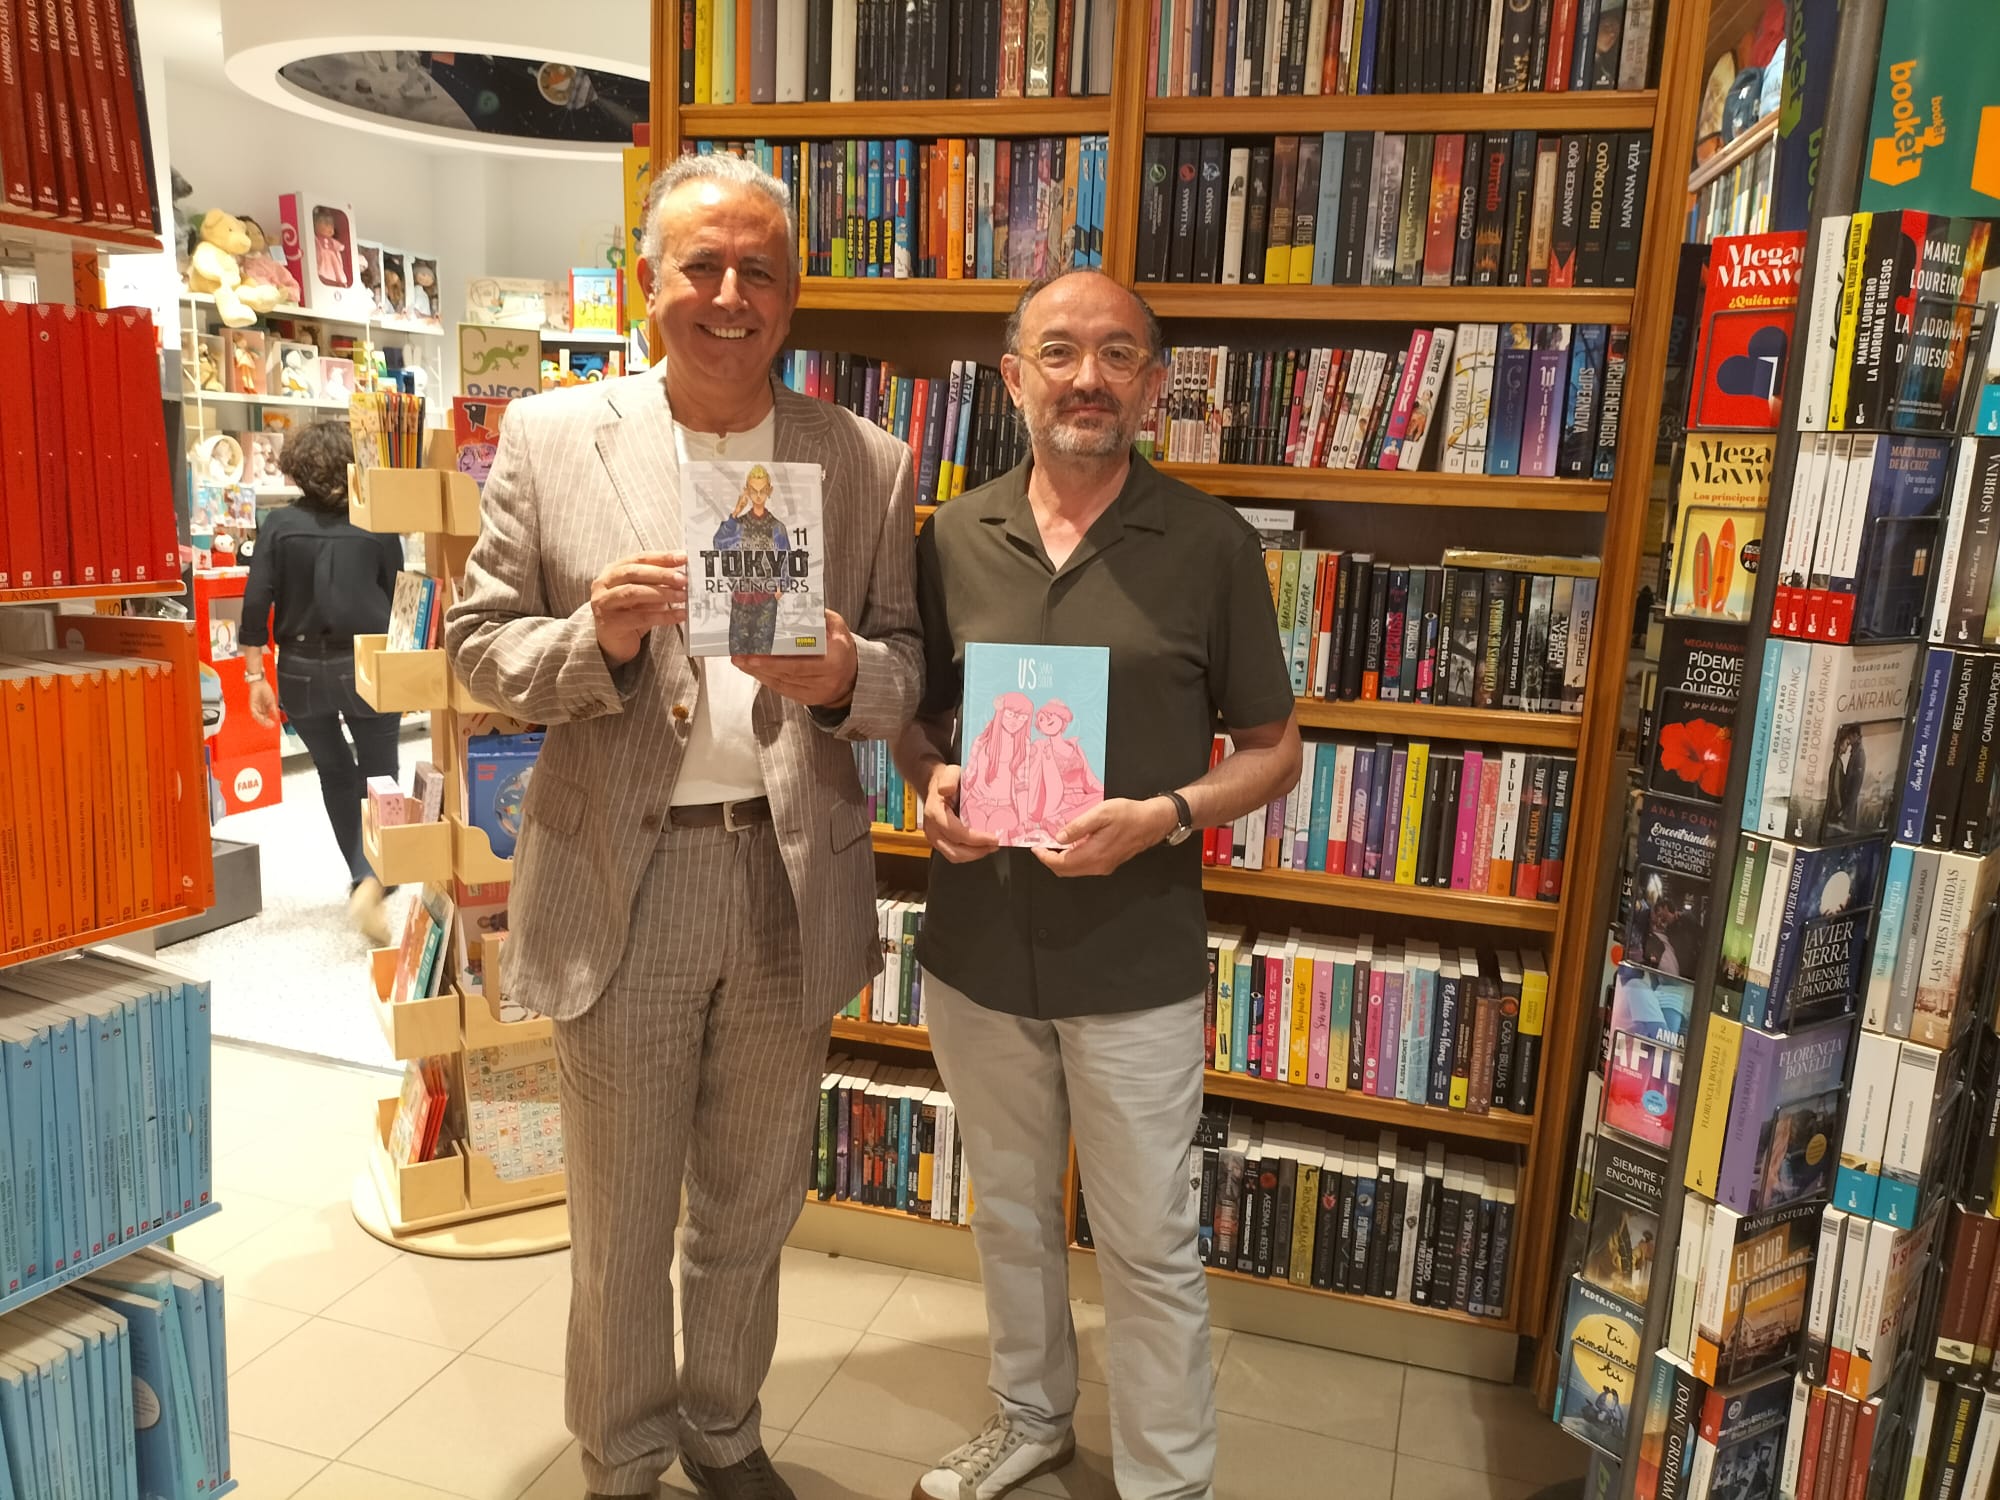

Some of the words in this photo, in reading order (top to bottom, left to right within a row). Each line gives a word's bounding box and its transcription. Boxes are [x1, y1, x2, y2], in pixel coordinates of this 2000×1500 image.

[89, 17, 102, 56] TEMPLO
[94, 58, 104, 70] EL
[1889, 59, 1923, 168] booket
[1930, 95, 1947, 143] booket
[1567, 140, 1579, 165] ROJO
[1628, 139, 1641, 172] AZUL
[1592, 141, 1609, 199] DORADO
[1181, 187, 1191, 223] LLAMAS
[1204, 187, 1214, 224] SINSAJO
[1562, 166, 1577, 228] AMANECER
[1620, 173, 1637, 228] MAÑANA
[1589, 200, 1602, 230] HIJO
[1179, 223, 1187, 237] EN
[1728, 243, 1806, 268] Mega
[1923, 239, 1961, 265] MANEL
[1878, 258, 1894, 300] HUESOS
[1909, 268, 1965, 297] LOUREIRO
[1728, 294, 1771, 309] ¿Quién
[1875, 301, 1886, 316] DE
[1856, 337, 1870, 365] MANEL
[1863, 276, 1878, 335] LOUREIRO
[1894, 313, 1910, 334] LA
[1915, 318, 1963, 341] ADRONA
[1868, 317, 1885, 365] LADRONA
[1912, 350, 1954, 370] HUESOS
[1316, 360, 1328, 392] TAKOPI
[1425, 375, 1436, 386] 10
[1866, 366, 1878, 382] LA
[1452, 382, 1469, 435] TRIBUTO
[1475, 388, 1488, 430] VALOR
[1535, 366, 1556, 457] Winter
[1573, 366, 1595, 435] SUPERNOVA
[1599, 356, 1625, 448] ARCHIENEMIGOS
[1690, 461, 1772, 486] Maxw
[793, 527, 808, 546] 11
[1975, 516, 1990, 535] LA
[700, 549, 810, 578] TOKYO
[705, 579, 809, 593] REVENGERS
[1489, 599, 1505, 636] SOMBRAS
[1367, 618, 1380, 669] EVERLESS
[1489, 635, 1501, 647] DE
[1547, 624, 1560, 661] CURA
[1555, 617, 1569, 668] MORTAL
[1576, 610, 1590, 667] PRUEBAS
[1684, 638, 1714, 649] MEGAN
[1018, 657, 1038, 689] US
[1483, 647, 1501, 692] CAZADORES
[1688, 650, 1744, 672] PÍDEME
[1963, 667, 1972, 682] EN
[1965, 658, 1975, 667] TI
[1686, 667, 1707, 682] LO
[1709, 670, 1742, 687] QUE
[1990, 672, 2000, 692] POR
[1837, 688, 1904, 713] CANFRANC
[1953, 684, 1969, 731] REFLEJADA
[1773, 713, 1783, 754] ROSARIO
[1778, 684, 1787, 710] RARO
[1777, 734, 1789, 776] VOLVER
[1787, 666, 1801, 724] CANFRANC
[1981, 693, 1999, 743] CAUTIVADA
[1952, 733, 1961, 746] DAY
[1914, 743, 1928, 767] Norton
[1980, 746, 1990, 761] DAY
[237, 779, 260, 791] FABA
[1911, 765, 1924, 792] Laura
[1976, 762, 1987, 784] SYLVIA
[1651, 805, 1676, 818] ANA
[1654, 837, 1682, 851] CIENTO
[1659, 846, 1711, 868] PULSACIONES
[1656, 854, 1673, 869] POR
[1673, 859, 1703, 874] MINUTO
[1789, 857, 1805, 894] SIERRA
[1920, 869, 1929, 887] MAZA
[1917, 894, 1924, 904] DE
[1938, 868, 1959, 924] HERIDAS
[1783, 893, 1796, 928] JAVIER
[1804, 920, 1854, 949] JAVIER
[1876, 946, 1889, 977] Manuel
[1887, 880, 1902, 922] Alegría
[1911, 922, 1919, 936] ARO
[1933, 926, 1949, 956] TRES
[38, 939, 76, 957] AÑOS
[1801, 942, 1850, 969] SIERRA
[1906, 938, 1917, 964] MUERTO
[1806, 963, 1850, 983] MENSAJE
[1929, 959, 1943, 982] LAS
[1269, 989, 1278, 1003] VEZ
[1444, 983, 1455, 995] El
[1801, 976, 1850, 996] PANDORA
[1269, 1004, 1277, 1019] TAL
[1442, 996, 1454, 1019] chico
[1501, 1020, 1512, 1045] CAZA
[1655, 1028, 1686, 1049] ANNA
[1720, 1024, 1727, 1034] 2
[1400, 1038, 1408, 1063] BRONTÉ
[1437, 1038, 1452, 1067] flores
[1778, 1037, 1844, 1068] FLORENCIA
[1399, 1063, 1408, 1086] ALISSA
[1496, 1053, 1509, 1089] BRUJAS
[1784, 1053, 1834, 1081] BONELLI
[1702, 1080, 1715, 1129] FLORENCIA
[1709, 1045, 1721, 1081] BONELLI
[1605, 1167, 1662, 1199] ENCONTRA
[1611, 1156, 1657, 1183] SIEMPRE
[1262, 1193, 1271, 1228] ASESINA
[1743, 1217, 1774, 1233] DANIEL
[1776, 1206, 1816, 1227] ESTULIN
[1459, 1208, 1475, 1258] PESADILLAS
[1259, 1235, 1268, 1261] REYES
[1416, 1240, 1427, 1275] MATERIA
[1736, 1253, 1749, 1282] EL
[1753, 1236, 1784, 1269] CLUB
[57, 1262, 96, 1284] AÑOS
[1423, 1247, 1434, 1281] OSCURA
[1416, 1276, 1424, 1287] LA
[1455, 1265, 1468, 1299] CIUDAD
[1580, 1287, 1621, 1313] FEDERICO
[1598, 1359, 1623, 1383] tú
[1674, 1380, 1691, 1425] JOHN
[1660, 1433, 1683, 1500] GRISHAM
